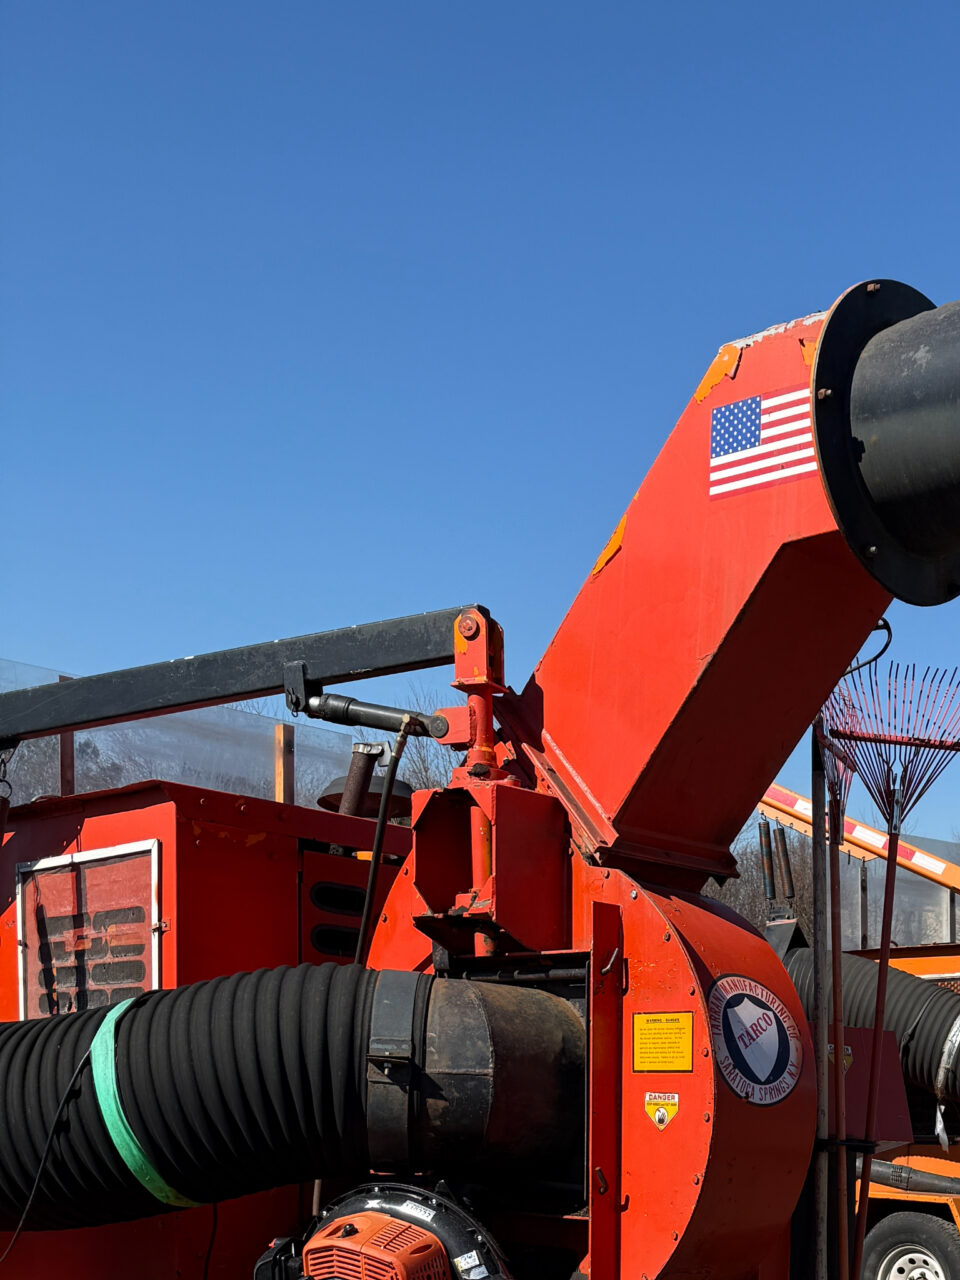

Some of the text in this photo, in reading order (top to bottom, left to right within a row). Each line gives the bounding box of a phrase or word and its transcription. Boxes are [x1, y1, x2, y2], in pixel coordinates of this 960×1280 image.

[719, 979, 790, 1024] MANUFACTURING
[737, 1012, 773, 1050] TARCO
[720, 1056, 755, 1099] SARATOGA
